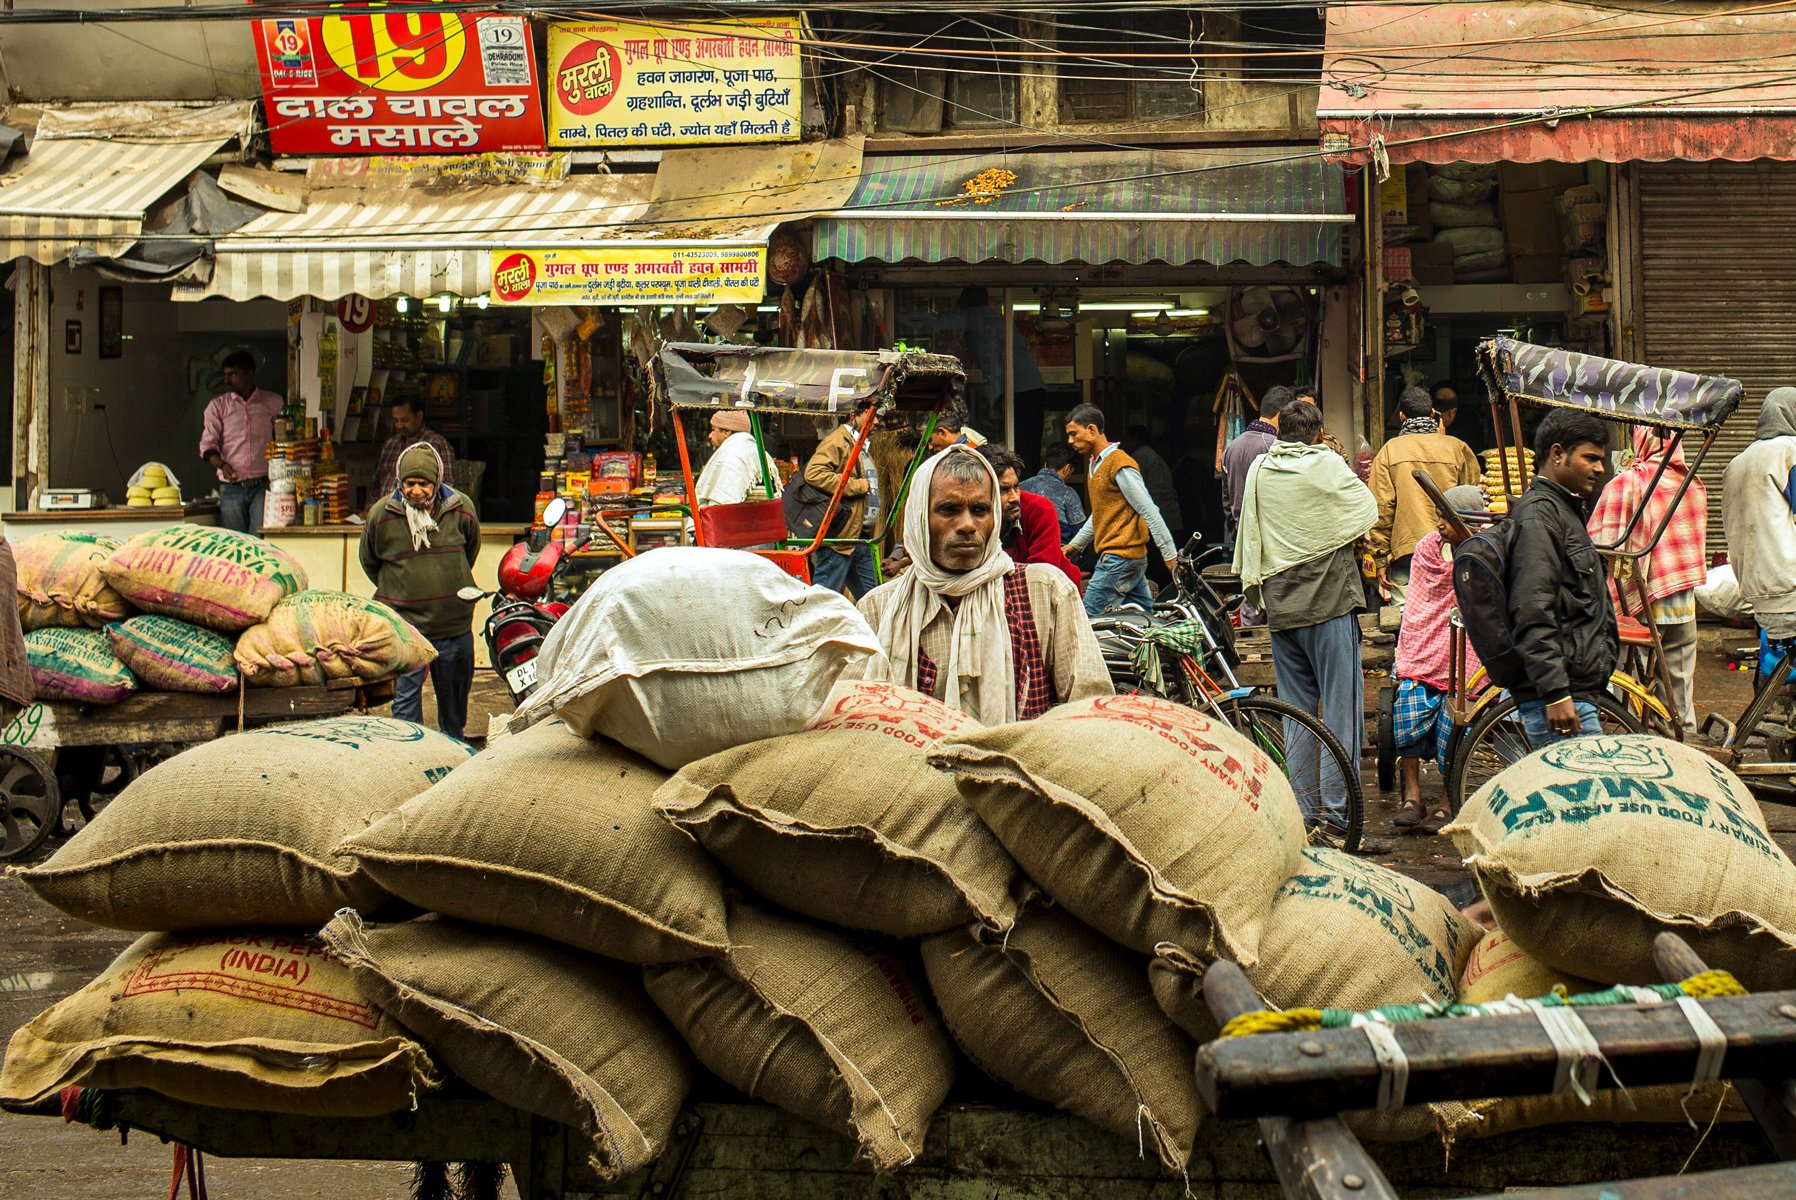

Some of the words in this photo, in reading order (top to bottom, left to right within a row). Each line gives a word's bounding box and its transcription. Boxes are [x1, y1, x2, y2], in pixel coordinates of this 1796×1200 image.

[280, 35, 298, 51] 19
[338, 0, 448, 79] 19
[493, 29, 513, 43] 19
[624, 39, 649, 65] गुगल
[738, 37, 759, 58] हवन
[559, 46, 612, 104] मुरली
[637, 71, 666, 87] हवन
[669, 69, 719, 85] जागरण,
[723, 69, 750, 88] पूजा
[752, 69, 778, 83] पाठ,
[584, 80, 614, 101] वाला
[726, 88, 752, 112] जड़ी
[755, 87, 791, 112] बुटियाँ
[272, 96, 378, 120] दाल
[385, 94, 529, 119] चावल
[327, 116, 482, 148] मसाले
[559, 123, 591, 140] ताम्बे,
[595, 122, 627, 138] पितल
[631, 123, 648, 138] की
[680, 121, 711, 137] ज्योत
[714, 120, 738, 136] यहाँ
[740, 119, 778, 135] मिलती
[781, 119, 792, 136] है
[496, 257, 530, 294] मुरली
[544, 263, 576, 278] गुगल
[604, 263, 630, 275] एण्ड
[688, 262, 715, 274] हवन
[719, 259, 759, 274] सामग्री
[511, 280, 531, 292] वाला
[535, 281, 548, 293] पूजा
[674, 280, 687, 293] पूजा
[740, 277, 748, 287] की
[343, 293, 370, 326] 19
[183, 555, 253, 588] DATES
[516, 666, 529, 678] DL
[519, 677, 527, 688] X
[4, 703, 43, 746] 89
[845, 721, 879, 732] USE
[883, 726, 927, 748] FOOD
[1158, 729, 1198, 758] FOOD
[1618, 802, 1653, 816] USE
[1658, 803, 1704, 828] FOOD
[1709, 820, 1781, 861] PRIMARY
[220, 947, 310, 986] (INDIA)
